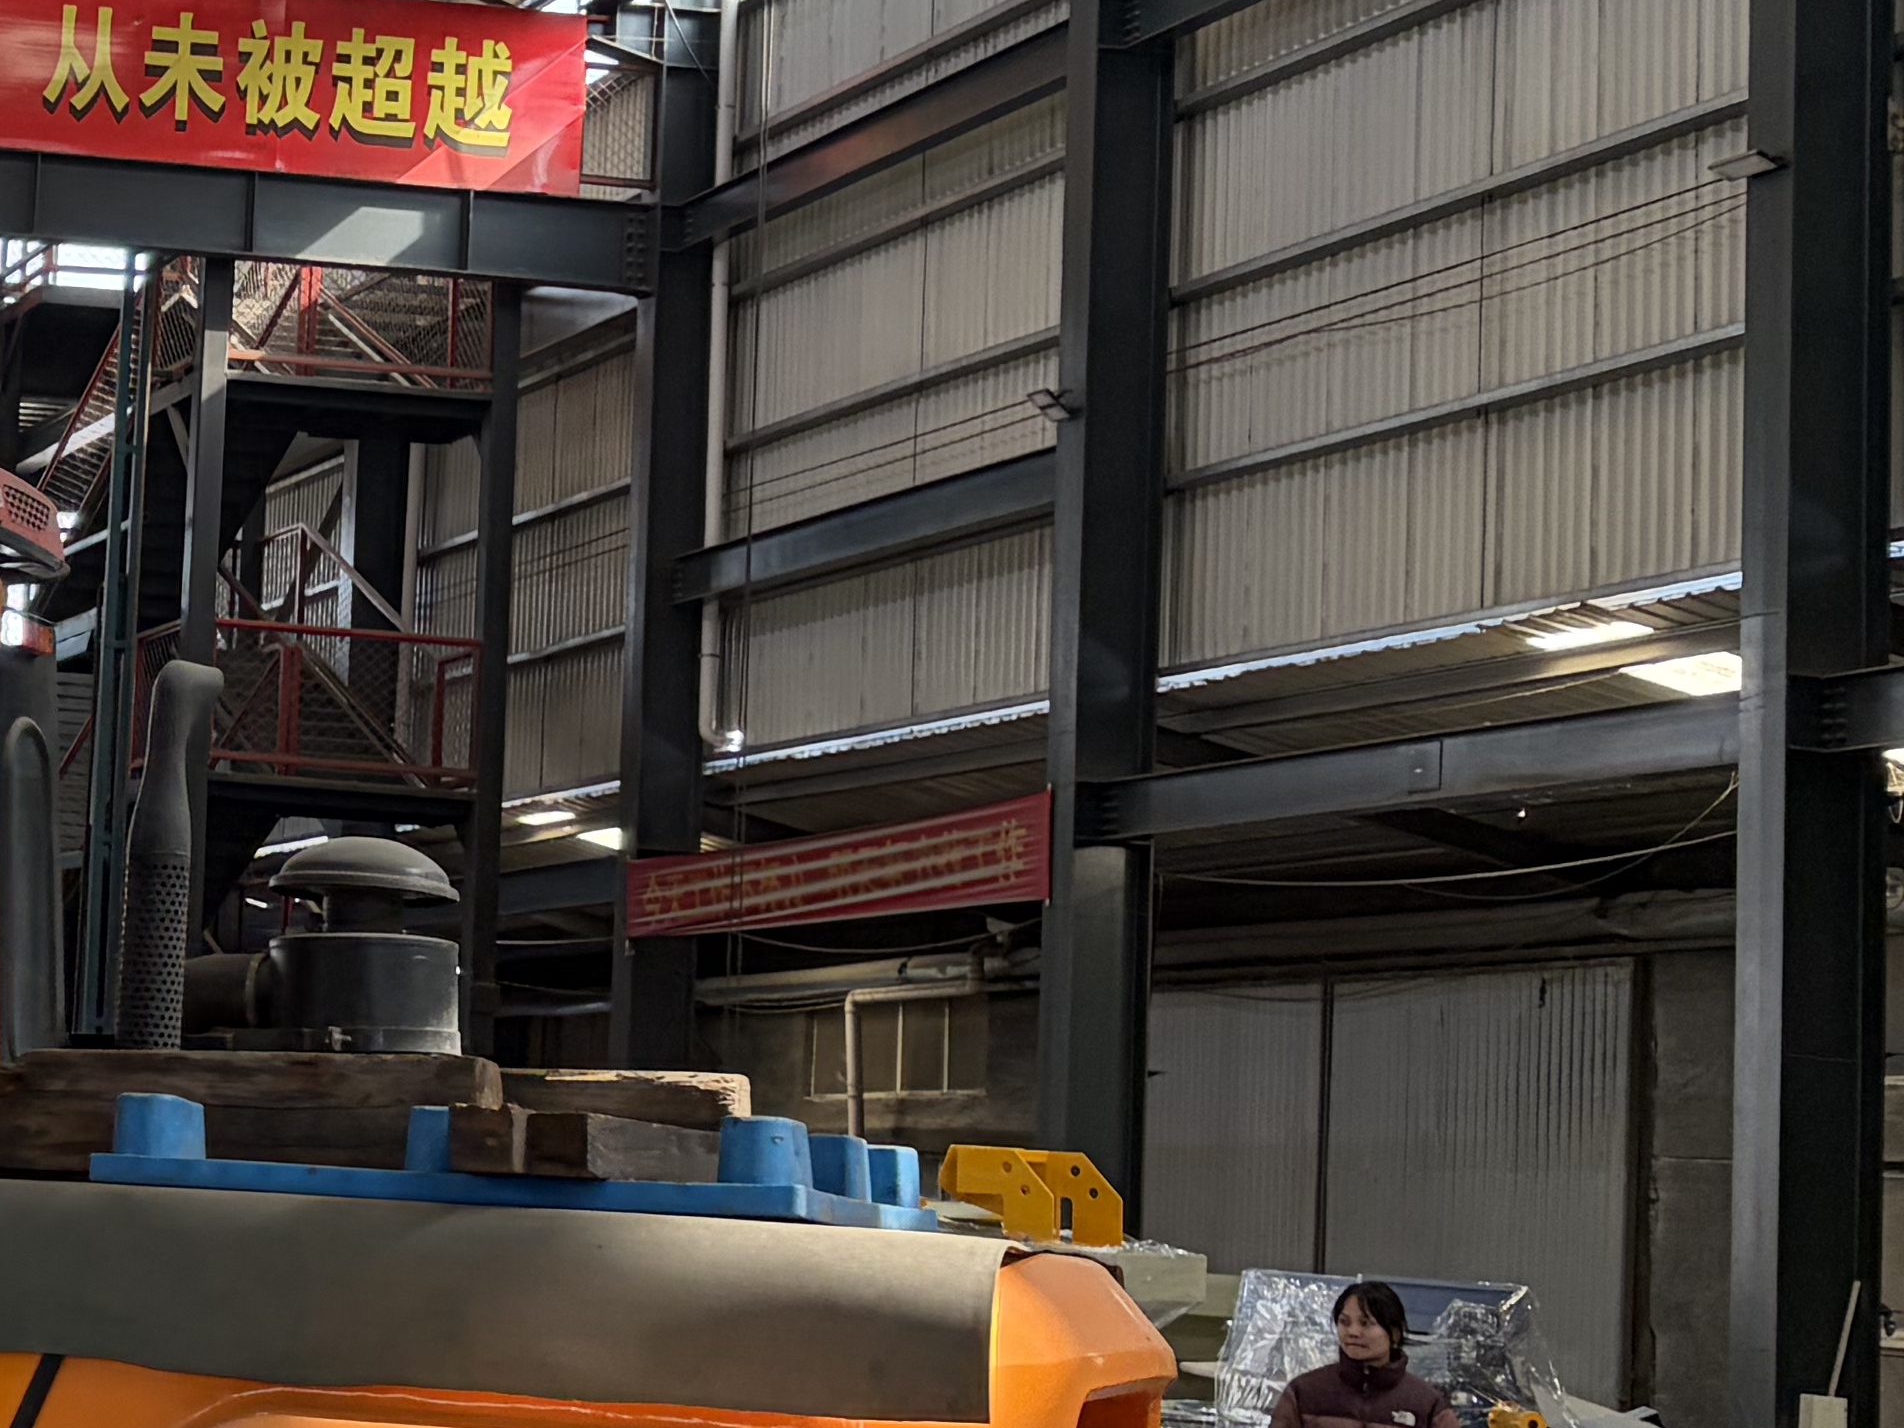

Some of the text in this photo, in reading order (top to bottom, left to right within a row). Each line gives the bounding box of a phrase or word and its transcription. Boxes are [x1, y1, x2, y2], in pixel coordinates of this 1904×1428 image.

[40, 2, 516, 149] 从未被超越
